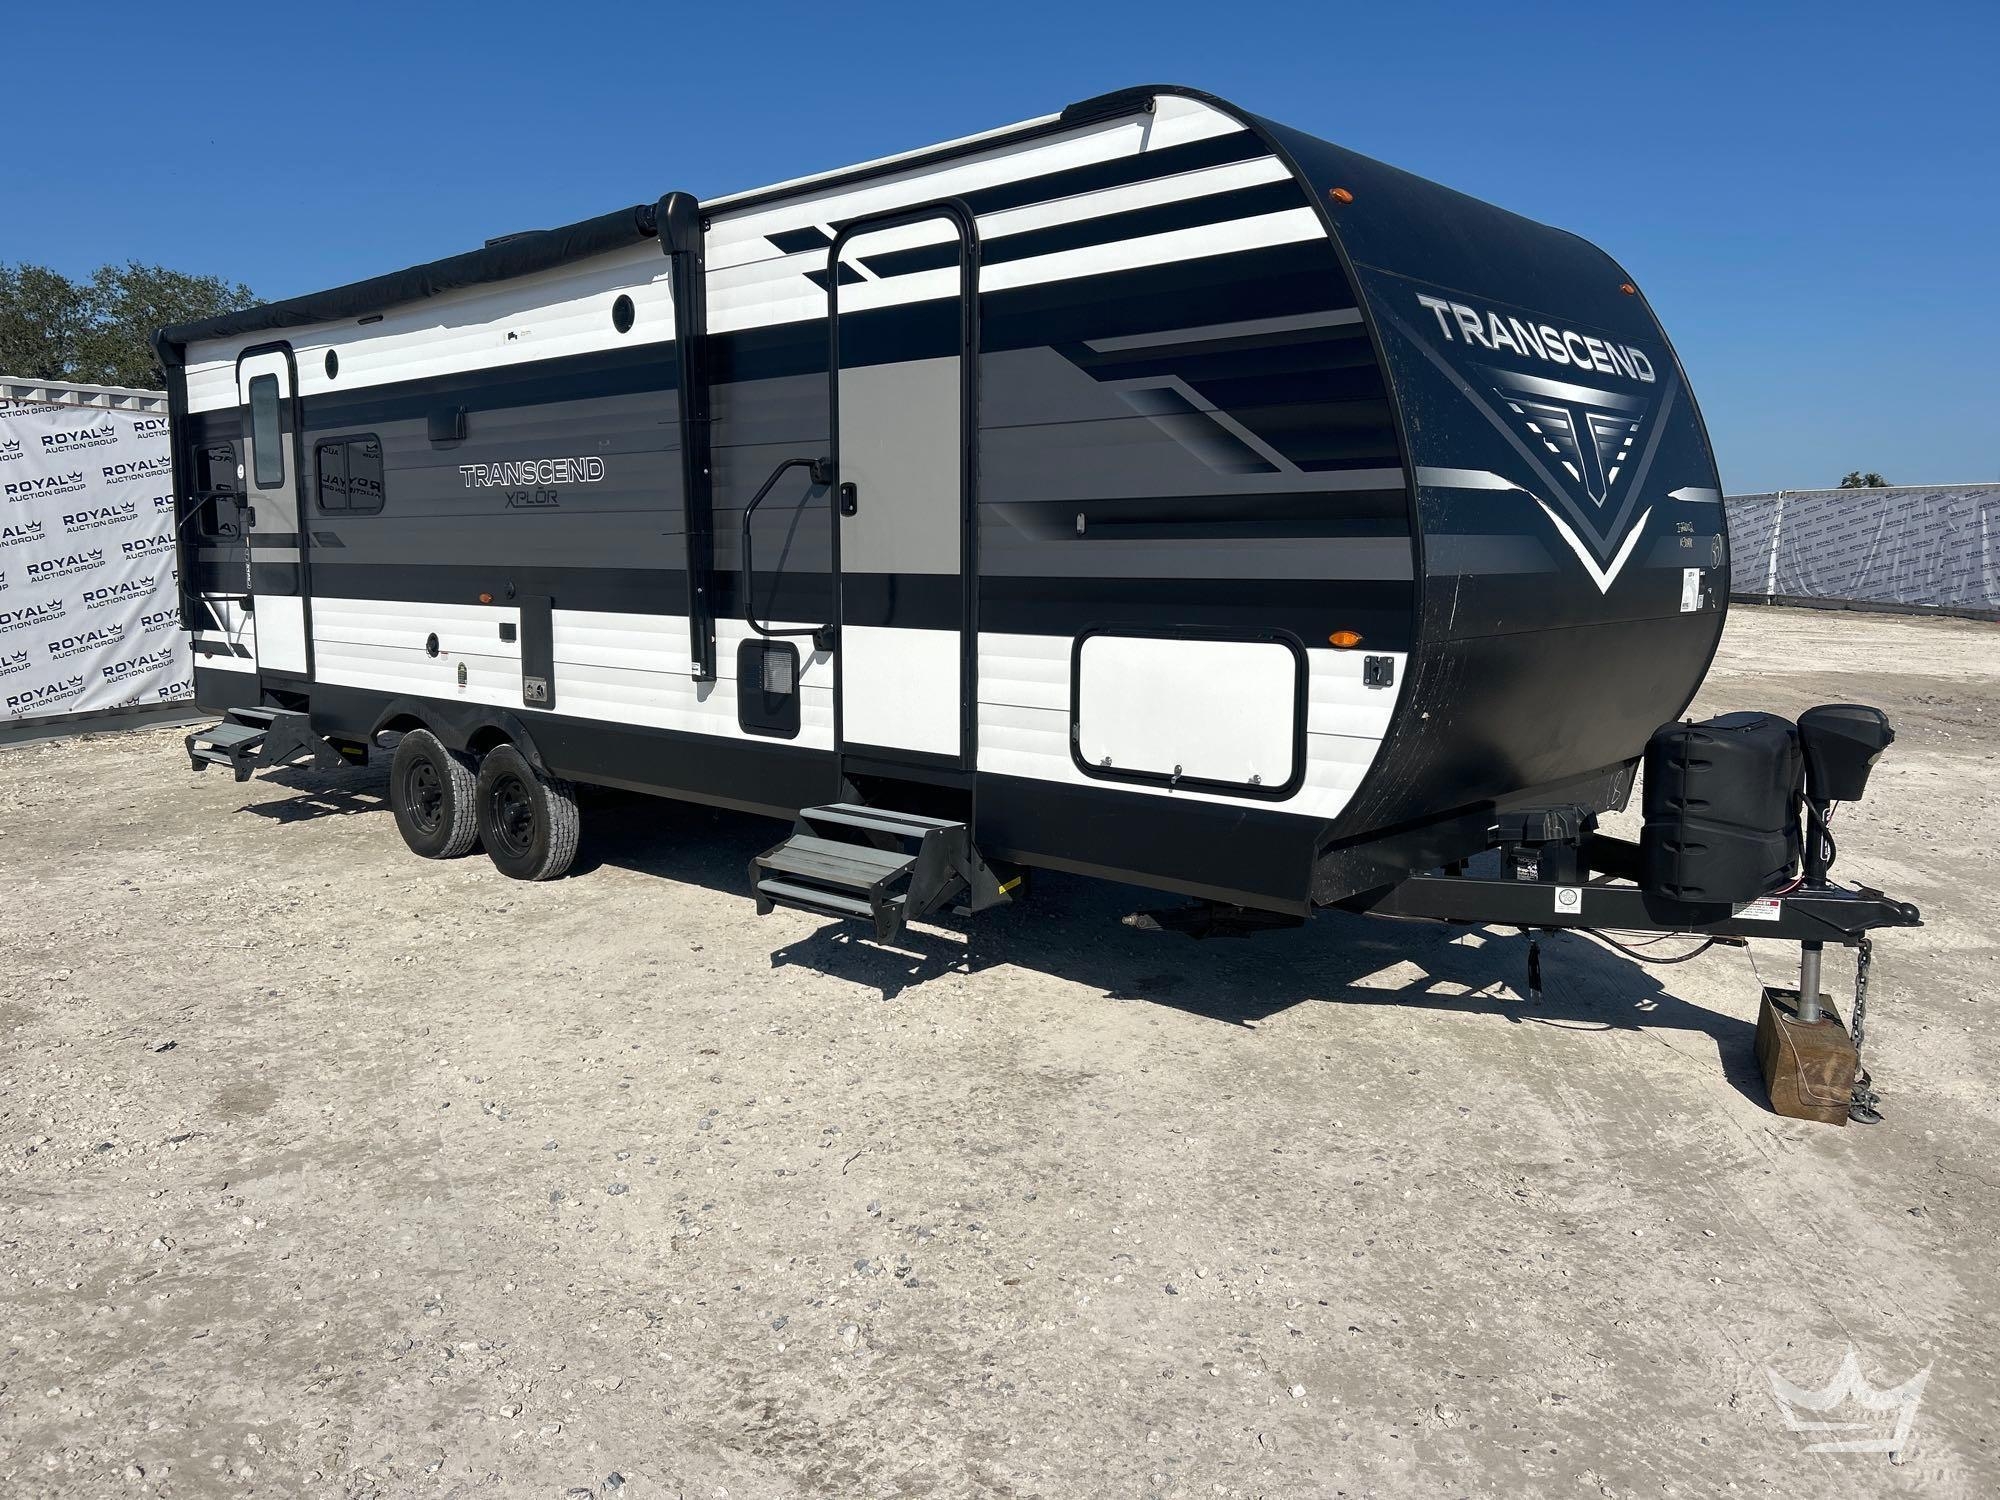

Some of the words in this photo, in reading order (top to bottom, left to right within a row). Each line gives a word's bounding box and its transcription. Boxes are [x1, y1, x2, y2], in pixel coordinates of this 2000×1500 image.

[1415, 292, 1656, 383] TRANSCEND
[0, 409, 29, 418] CTION
[32, 405, 65, 414] GROUP
[134, 418, 170, 432] ROY
[41, 429, 102, 446] ROYAL
[45, 443, 86, 454] AUCTION
[88, 437, 118, 448] GROUP
[0, 452, 23, 462] OUP
[102, 460, 158, 478] ROYAL
[106, 473, 144, 485] AUCTION
[146, 467, 173, 478] GROUP
[459, 456, 605, 488] TRANSCEND
[4, 475, 68, 495] ROYAL
[9, 490, 52, 503] AUCTION
[54, 484, 86, 495] GROUP
[62, 506, 121, 526] ROYAL
[67, 520, 107, 533] AUCTION
[108, 513, 138, 525] GROUP
[11, 533, 45, 546] GROUP
[122, 533, 176, 553] ROYAL
[27, 553, 89, 575] ROYAL
[125, 548, 163, 561] AUCTION
[31, 570, 72, 583] AUCTION
[74, 560, 106, 573] GROUP
[83, 581, 141, 603] ROYAL
[86, 596, 126, 610] AUCTION
[127, 587, 157, 599] GROUP
[0, 605, 48, 625] OYAL
[0, 621, 32, 634] CTION
[33, 611, 66, 625] GROUP
[48, 629, 108, 653] ROYAL
[52, 644, 93, 660] AUCTION
[95, 635, 125, 648] GROUP
[102, 654, 159, 677] ROYAL
[106, 668, 144, 684] AUCTION
[146, 659, 175, 672] GROUP
[6, 681, 69, 707] ROYAL
[11, 698, 52, 715] AUCTION
[54, 687, 86, 701] GROUP
